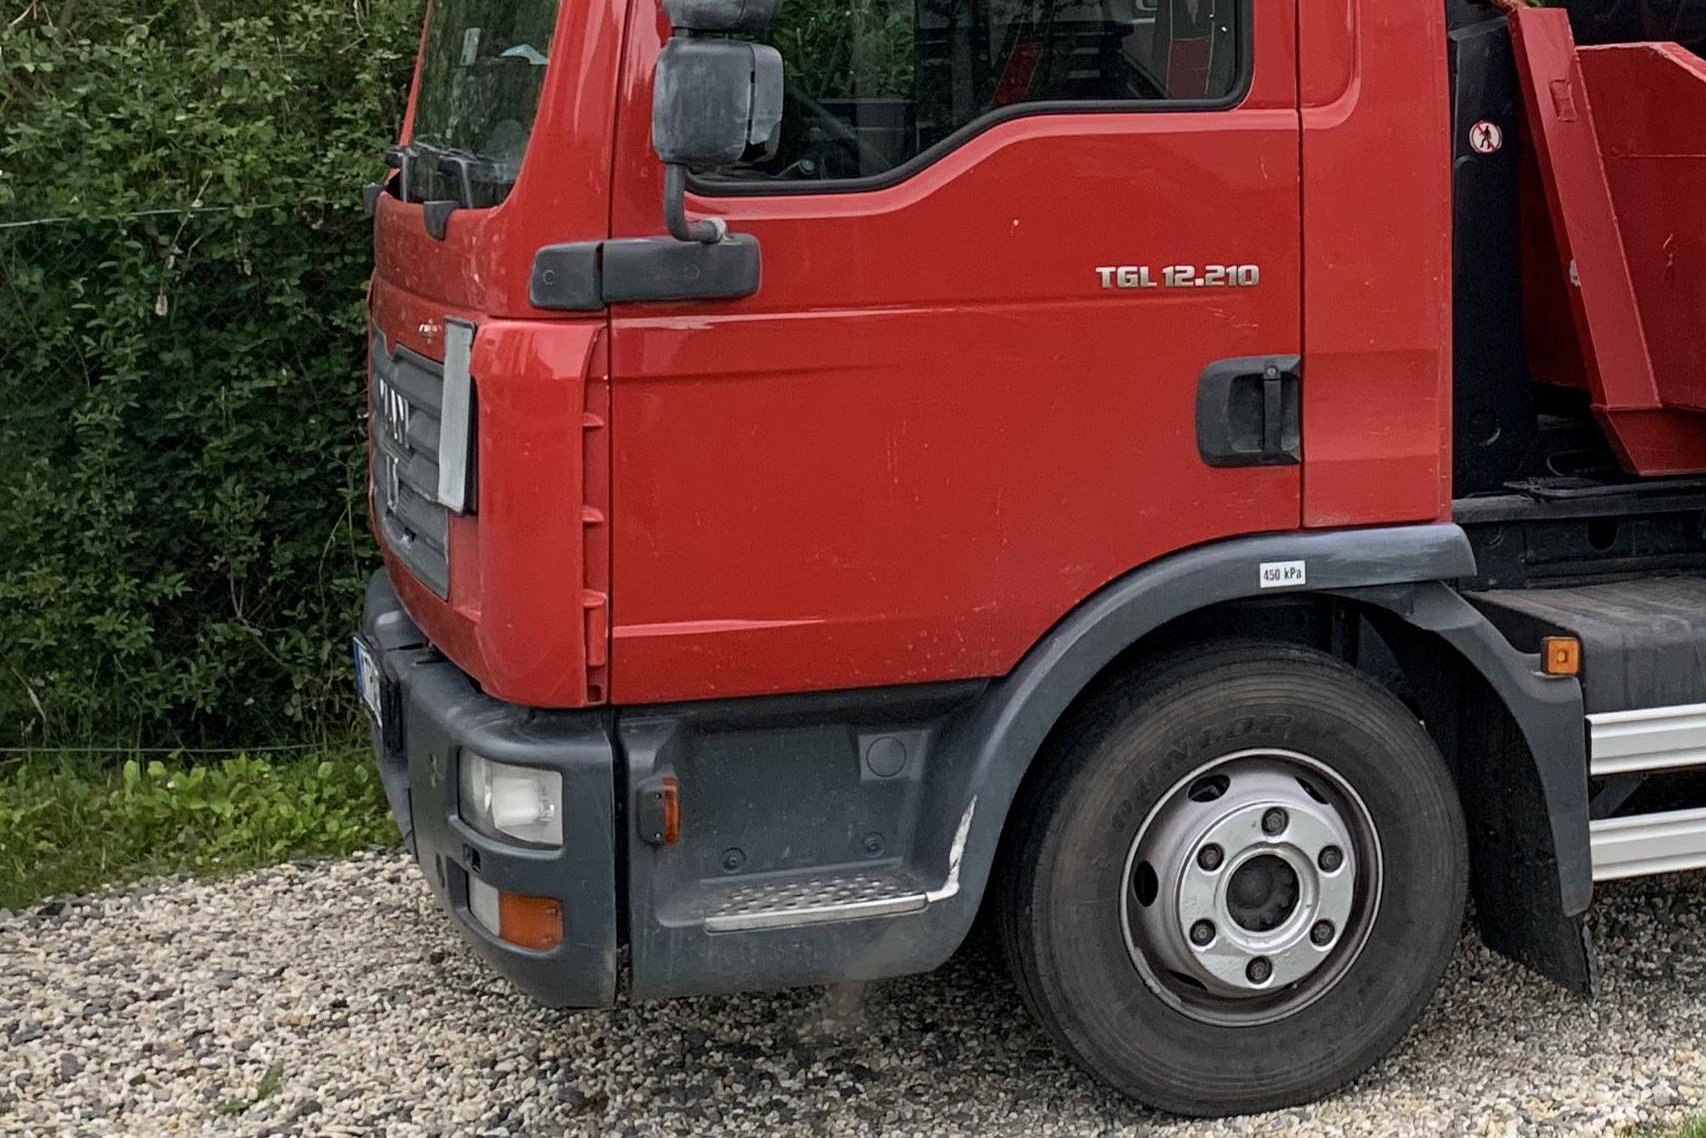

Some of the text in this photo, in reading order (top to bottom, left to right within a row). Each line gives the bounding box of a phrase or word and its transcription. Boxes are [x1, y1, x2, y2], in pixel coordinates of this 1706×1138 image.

[1095, 264, 1260, 289] TGL 12.210
[1263, 566, 1302, 581] 450 kPa
